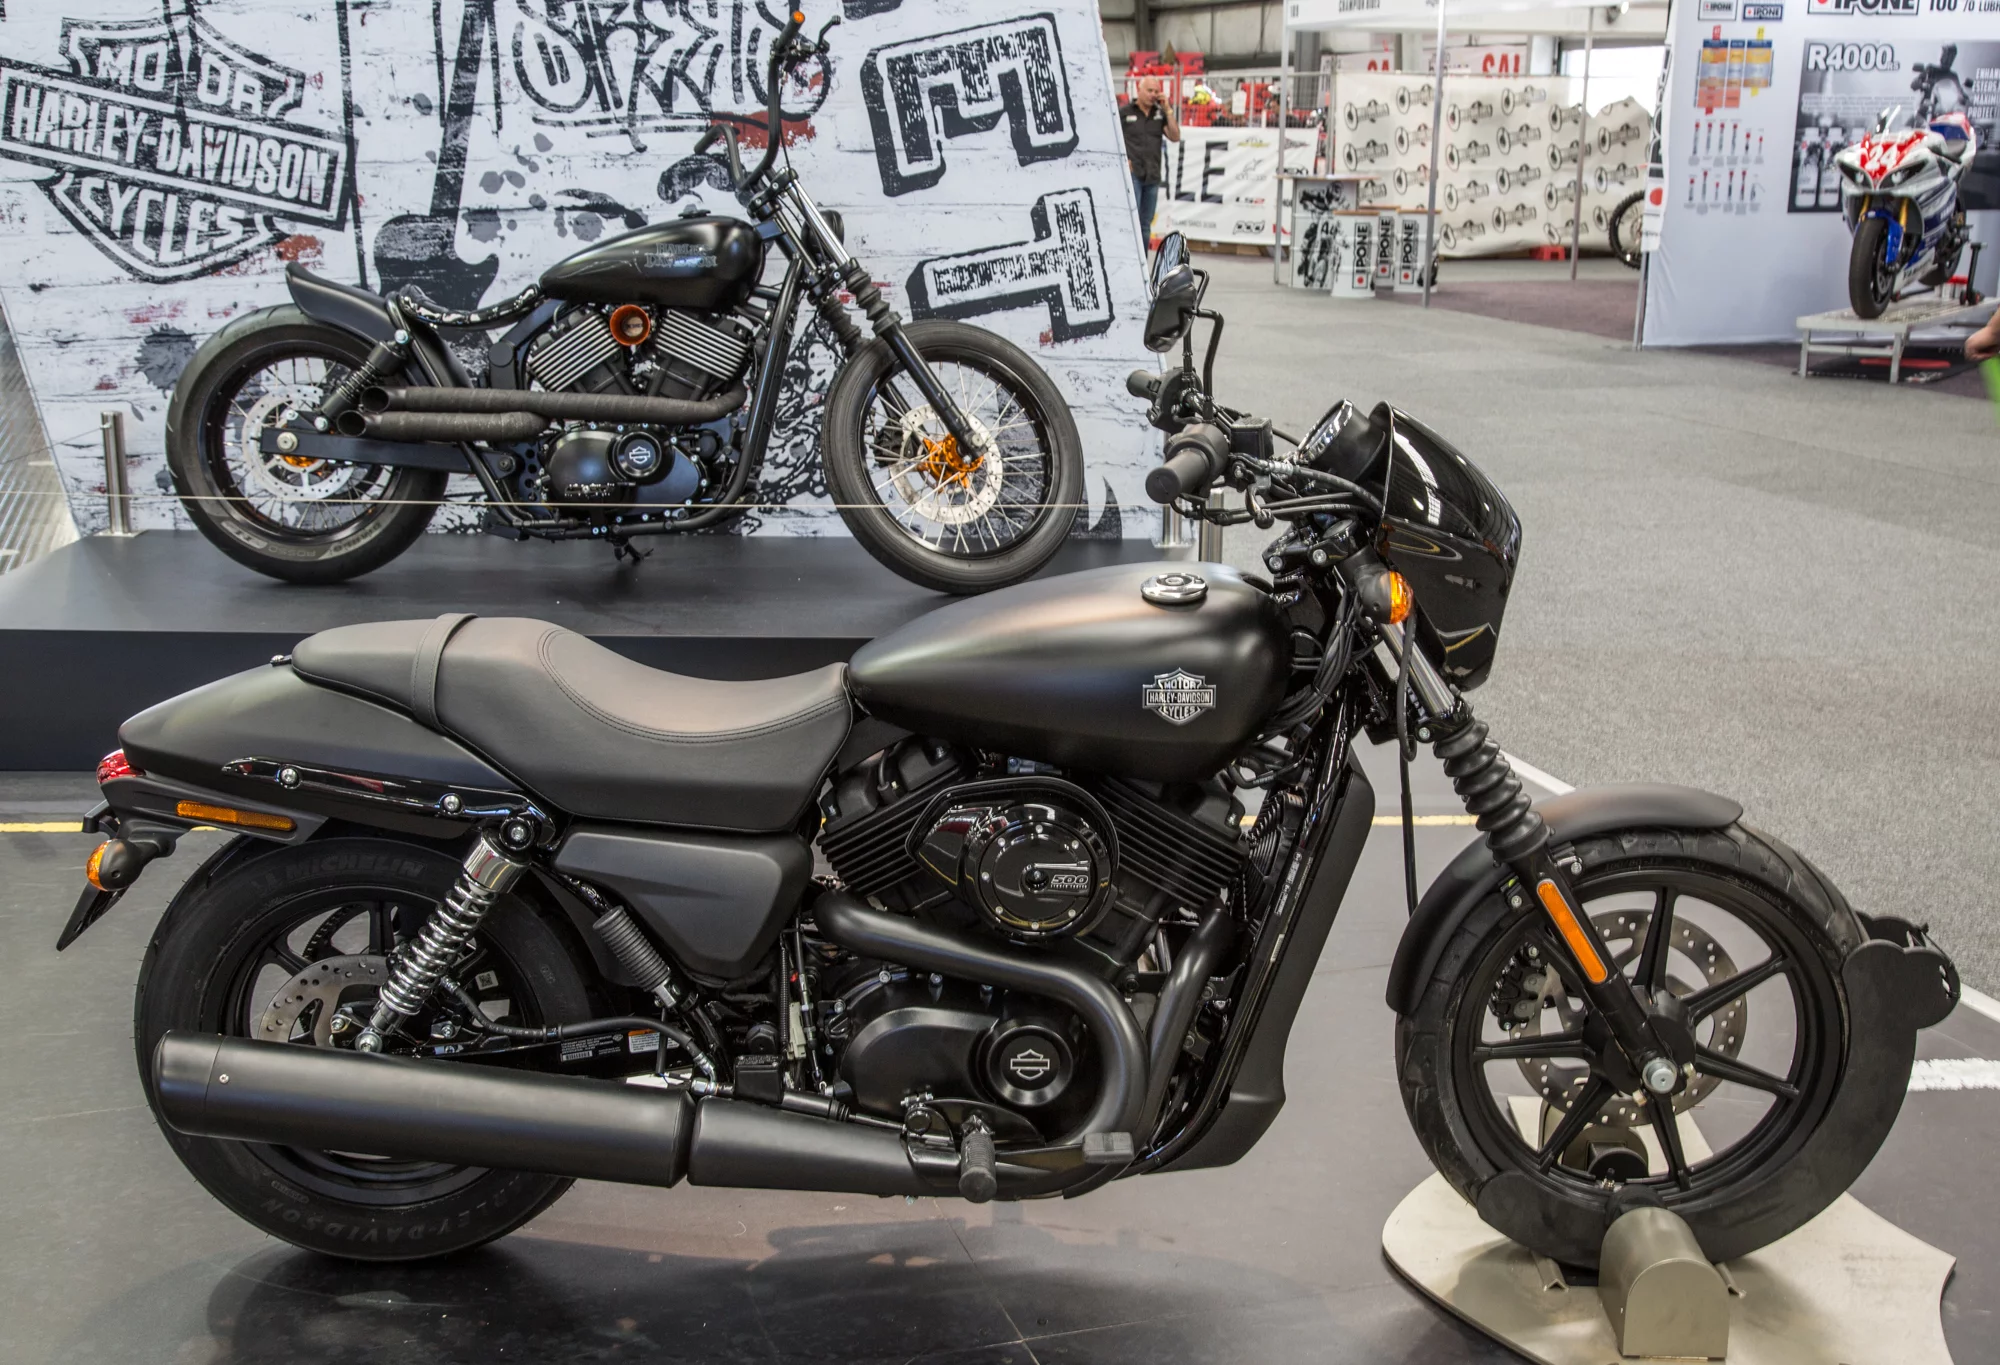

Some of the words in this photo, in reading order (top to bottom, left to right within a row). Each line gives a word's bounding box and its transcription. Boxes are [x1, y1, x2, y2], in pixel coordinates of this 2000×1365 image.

[11, 84, 331, 206] HARLEY-DAVIDSON
[1865, 143, 1899, 170] 24
[80, 176, 247, 263] CYCLES
[1356, 223, 1368, 274] IPONE
[1380, 218, 1391, 264] IPONE
[1402, 221, 1413, 269] IPONE
[1164, 676, 1196, 689] MOTOR
[1149, 691, 1210, 703] HARLEY-DAVIDSON
[1163, 705, 1196, 720] CYCLES
[285, 853, 426, 881] MICHELIN
[1050, 874, 1089, 885] 500
